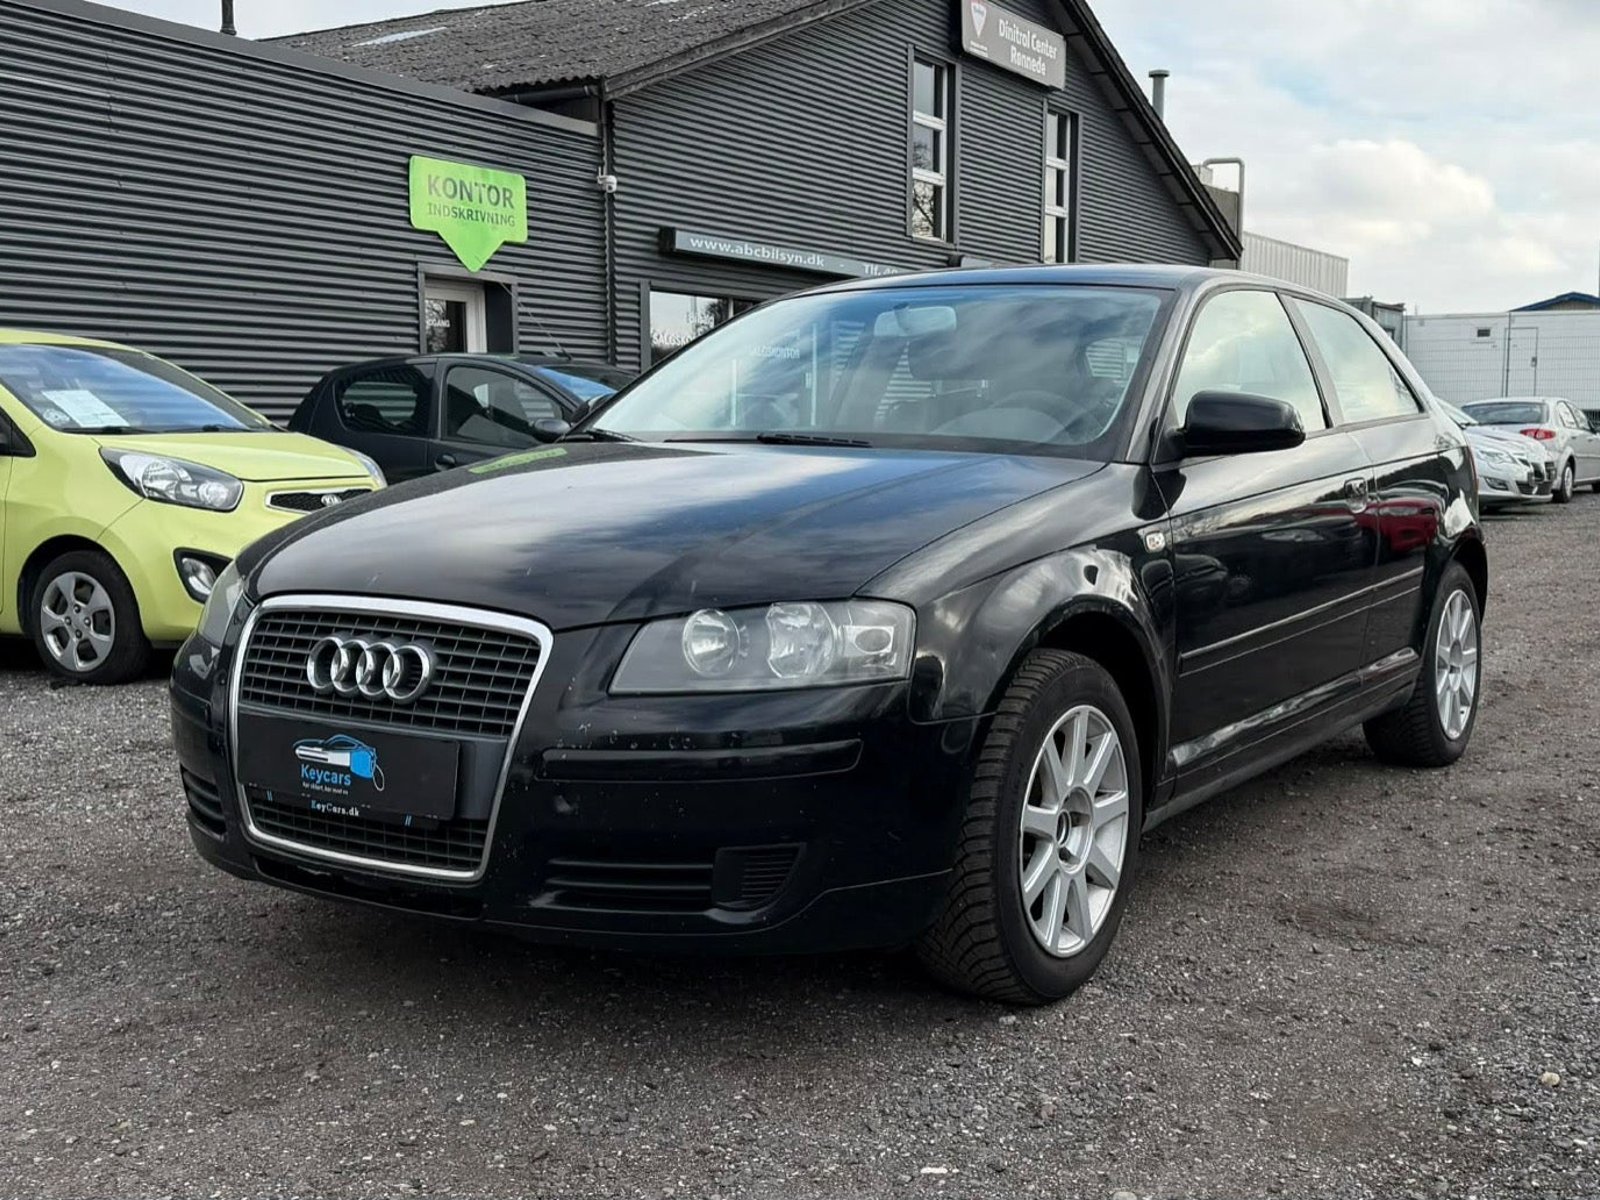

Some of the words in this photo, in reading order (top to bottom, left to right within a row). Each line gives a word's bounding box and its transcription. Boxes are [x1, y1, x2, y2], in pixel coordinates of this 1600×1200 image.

[999, 18, 1030, 49] Dinitrol
[1031, 33, 1057, 60] Center
[427, 174, 514, 209] KONTOR
[427, 202, 516, 227] INDSKRIVNING
[689, 238, 825, 267] www.abcbilsyn.dk
[301, 763, 351, 786] Keycars
[311, 799, 360, 817] KeyCars.dk
